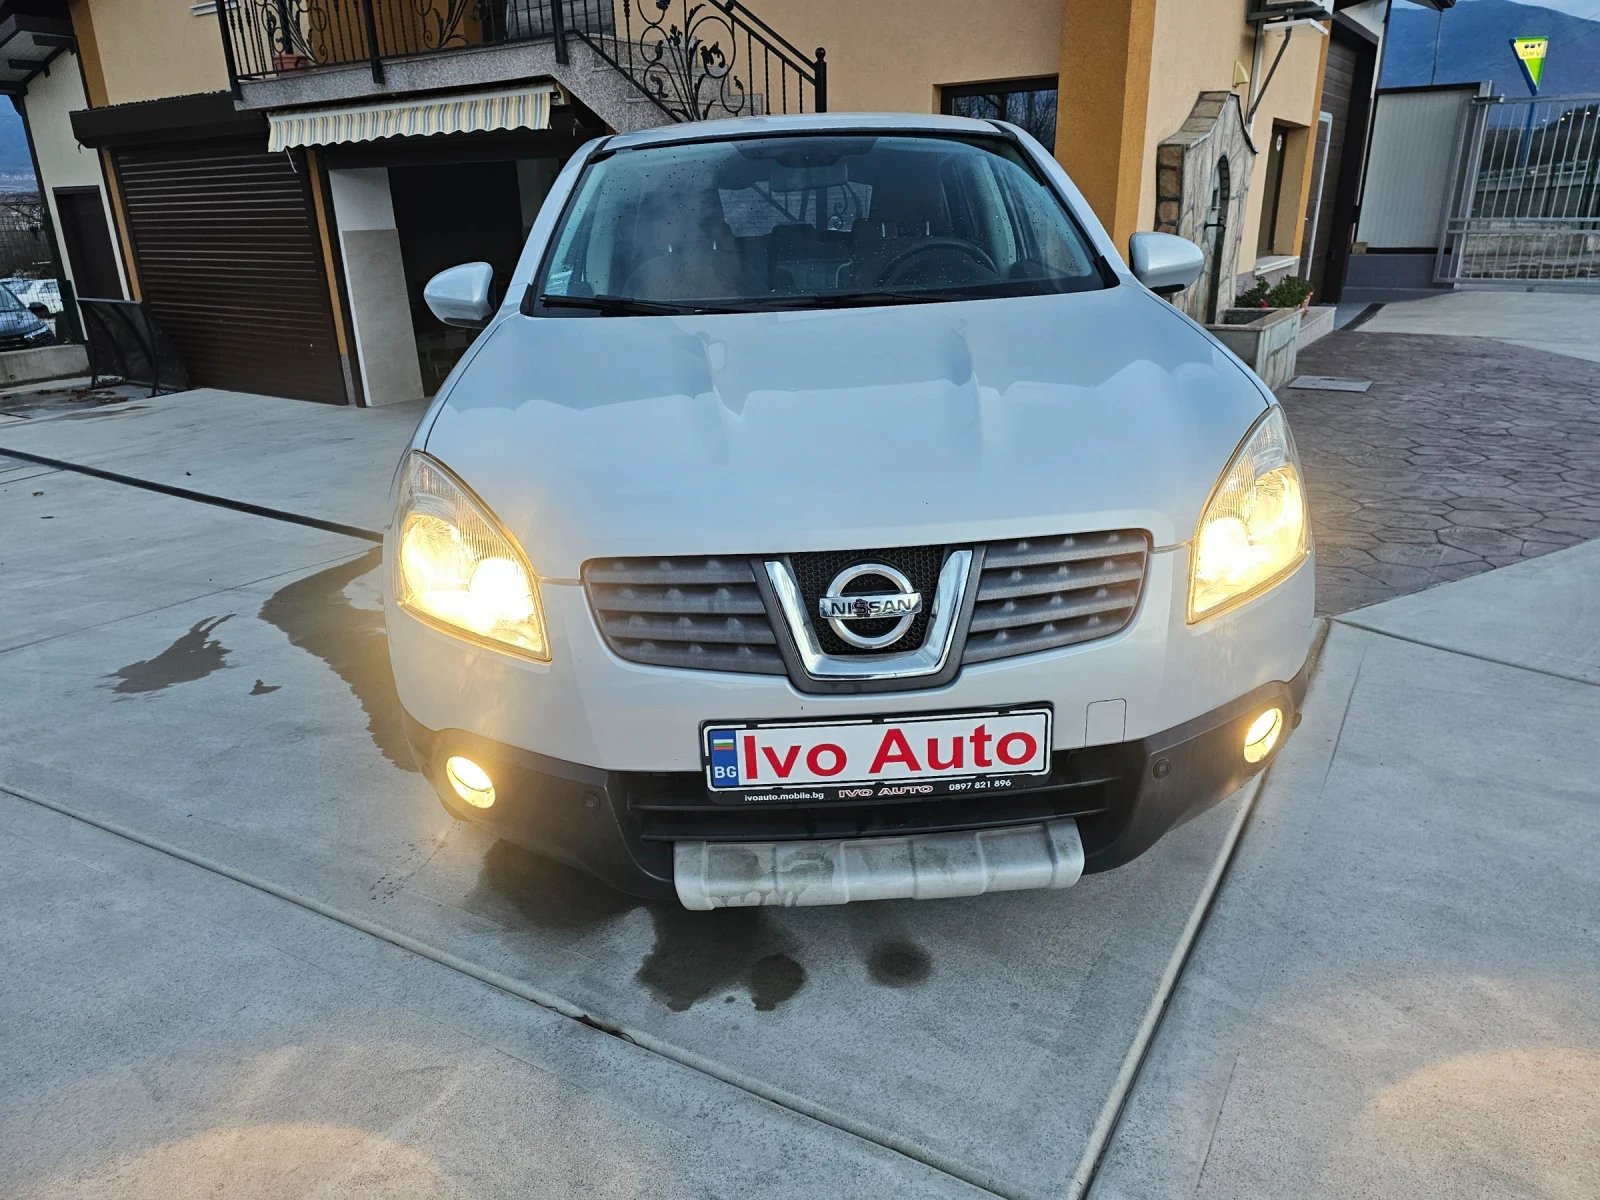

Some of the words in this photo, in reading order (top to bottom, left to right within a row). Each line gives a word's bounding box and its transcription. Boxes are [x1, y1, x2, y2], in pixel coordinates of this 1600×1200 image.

[830, 597, 912, 615] NISSAN
[743, 735, 848, 780] Ivo
[868, 723, 1038, 775] Auto
[714, 766, 737, 779] BG
[838, 788, 873, 798] IVO
[877, 784, 934, 797] AUTO
[948, 781, 972, 791] 0897
[974, 780, 991, 790] 821
[993, 779, 1012, 788] 896
[744, 790, 825, 802] ivoauto.mobile.bg
